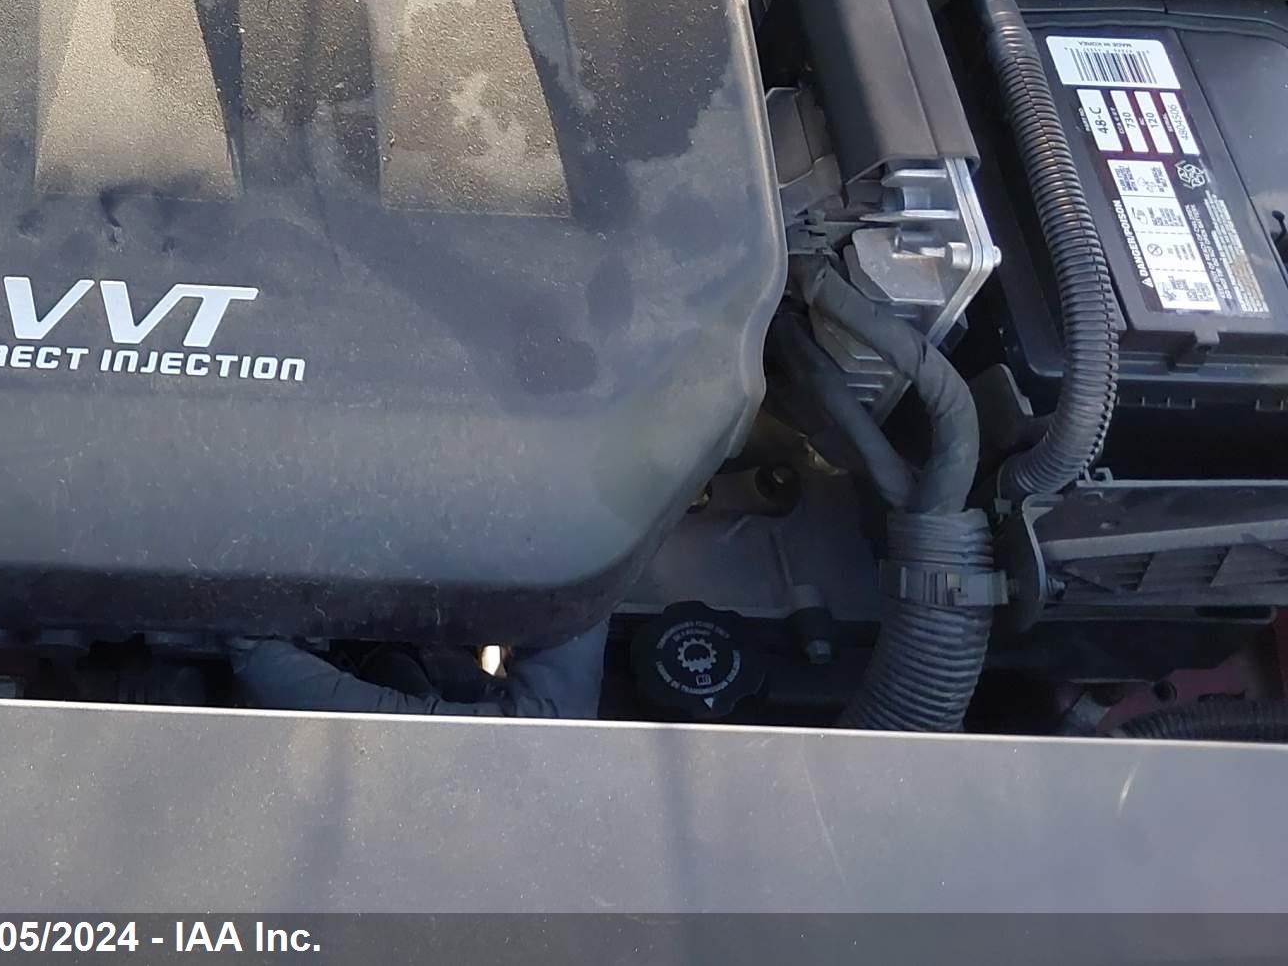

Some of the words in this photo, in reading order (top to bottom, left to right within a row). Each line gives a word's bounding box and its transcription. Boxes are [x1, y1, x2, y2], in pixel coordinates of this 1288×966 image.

[1122, 111, 1137, 129] 730
[1145, 112, 1159, 129] 120
[3, 276, 260, 348] VVT
[100, 349, 306, 381] INJECTION
